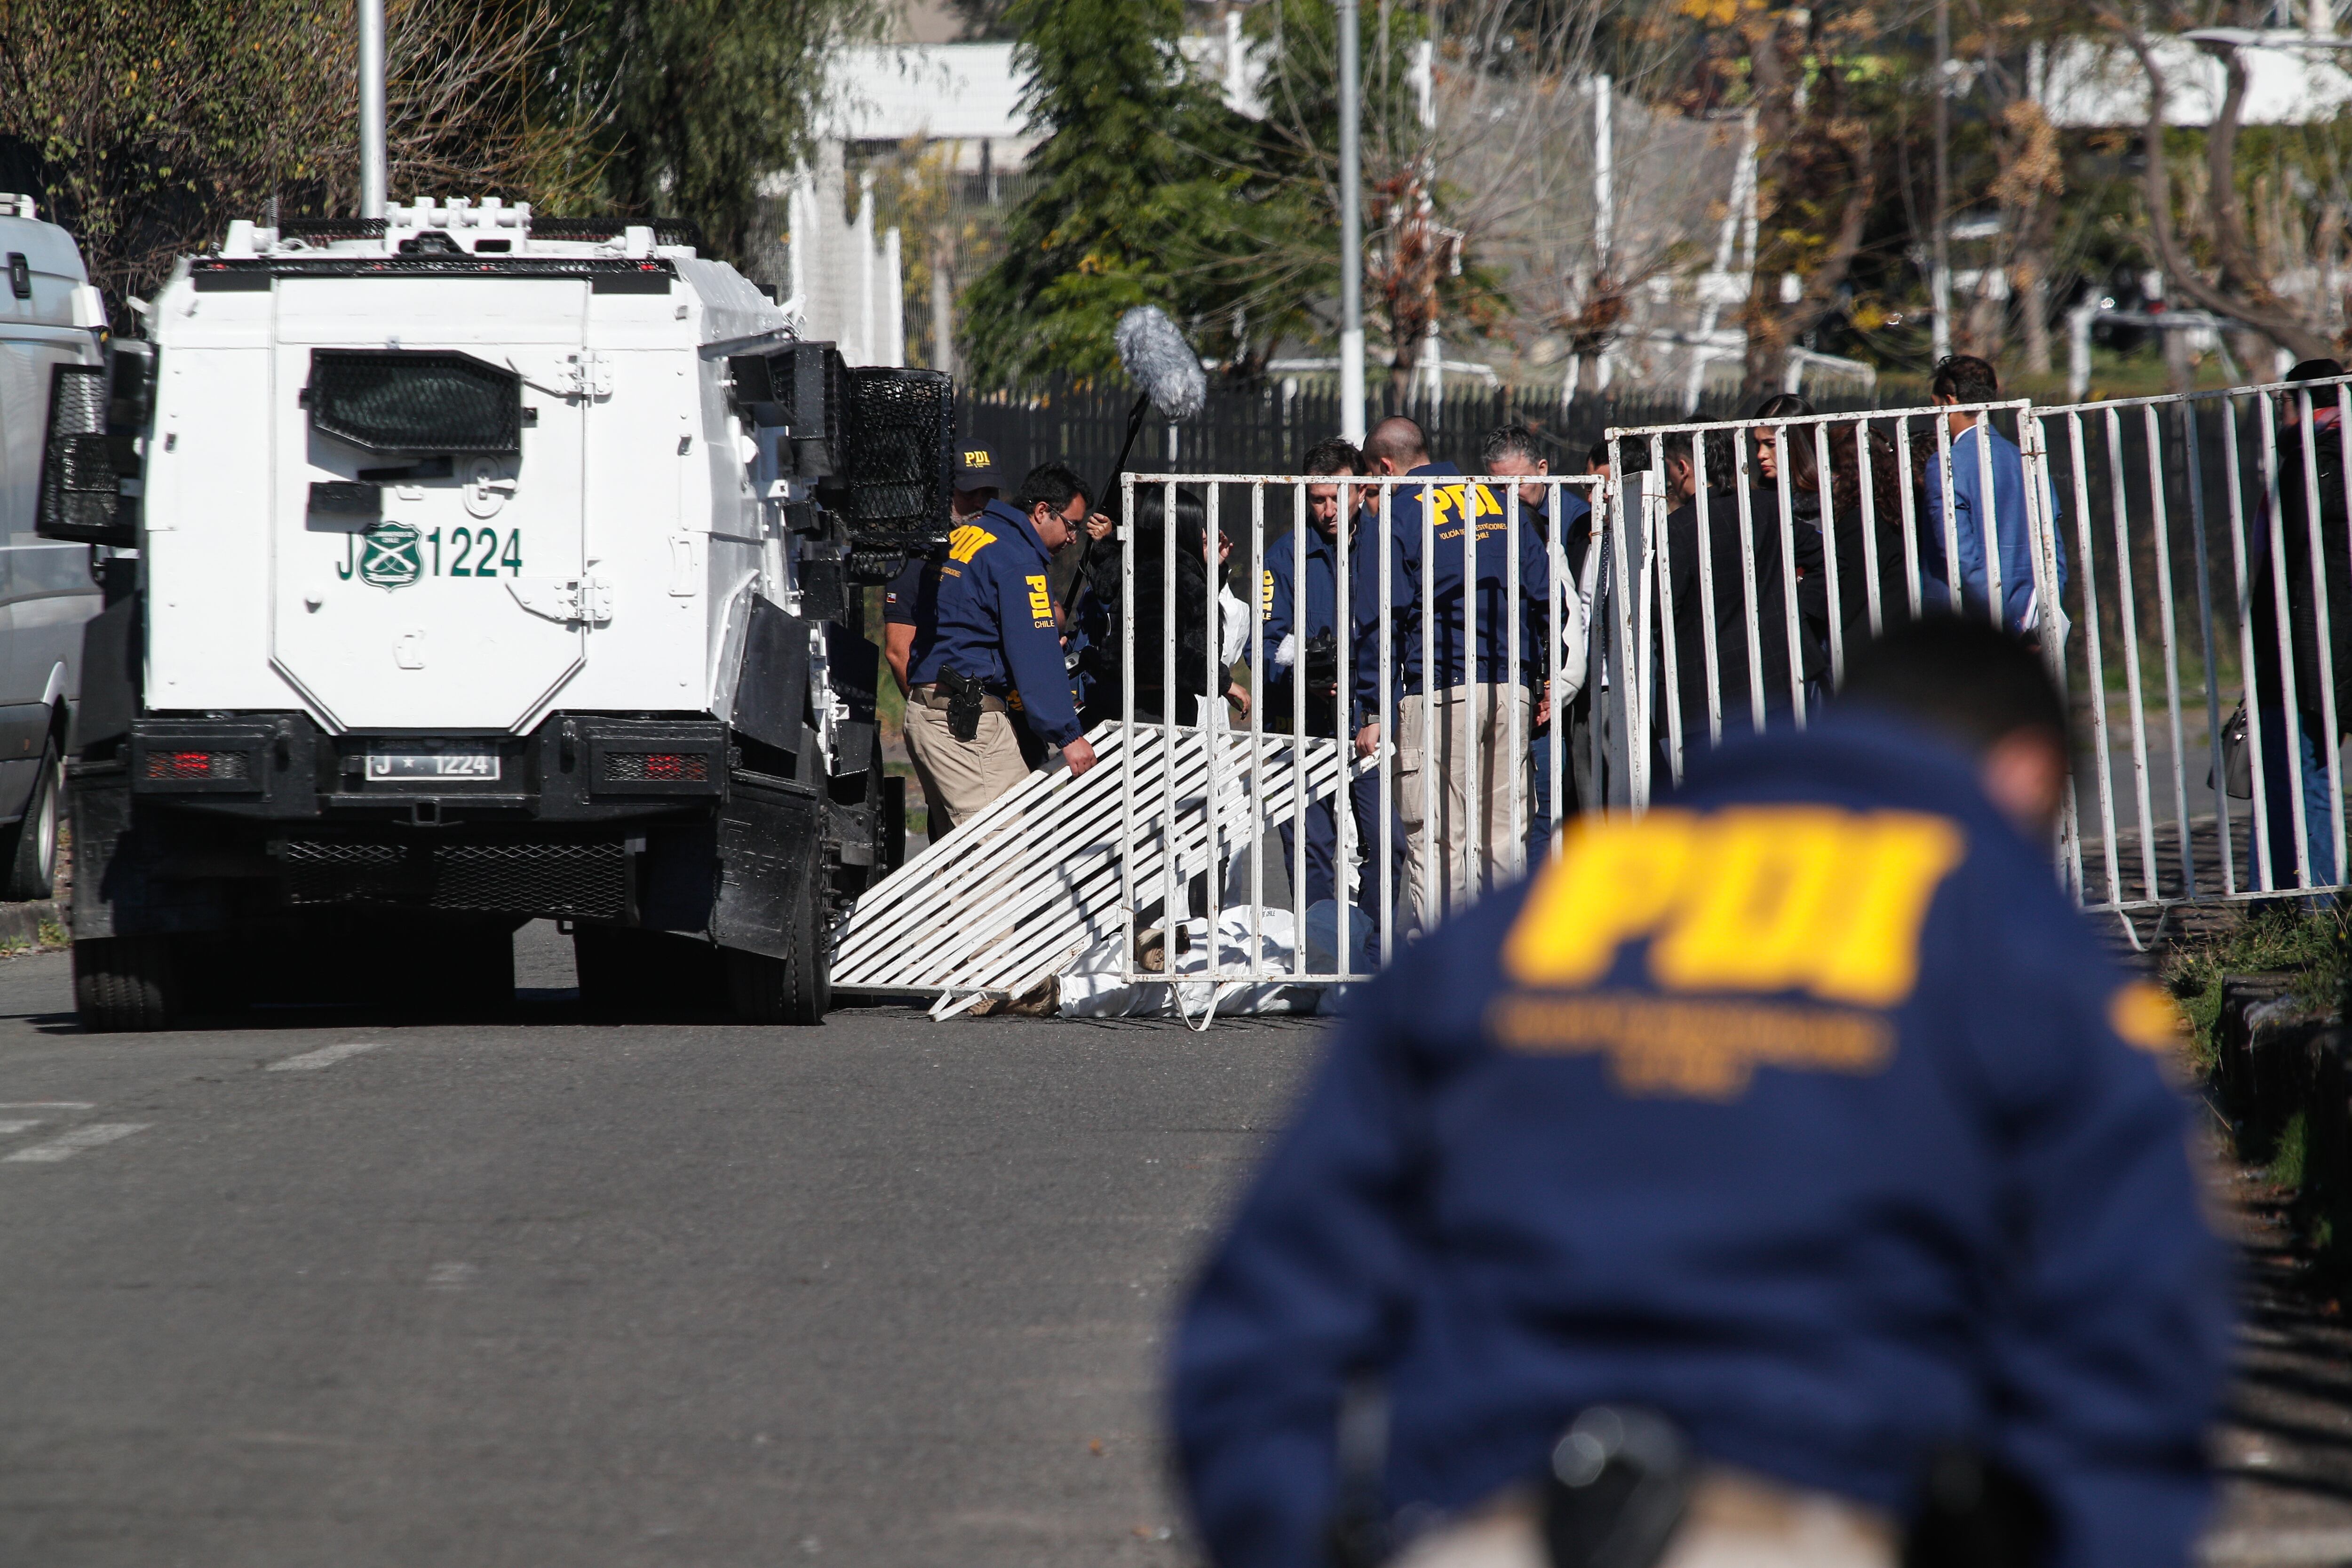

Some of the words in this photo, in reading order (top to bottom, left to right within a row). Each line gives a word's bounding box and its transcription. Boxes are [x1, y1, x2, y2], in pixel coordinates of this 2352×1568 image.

[964, 450, 990, 464] PDI
[1414, 484, 1503, 526] PDI
[335, 532, 353, 581] J
[426, 526, 523, 577] 1224
[949, 525, 998, 565] PDI
[1025, 575, 1053, 619] PDI
[1034, 620, 1055, 629] CHILE
[375, 753, 391, 775] J
[432, 752, 489, 774] 1224
[1506, 806, 1961, 1007] PDI
